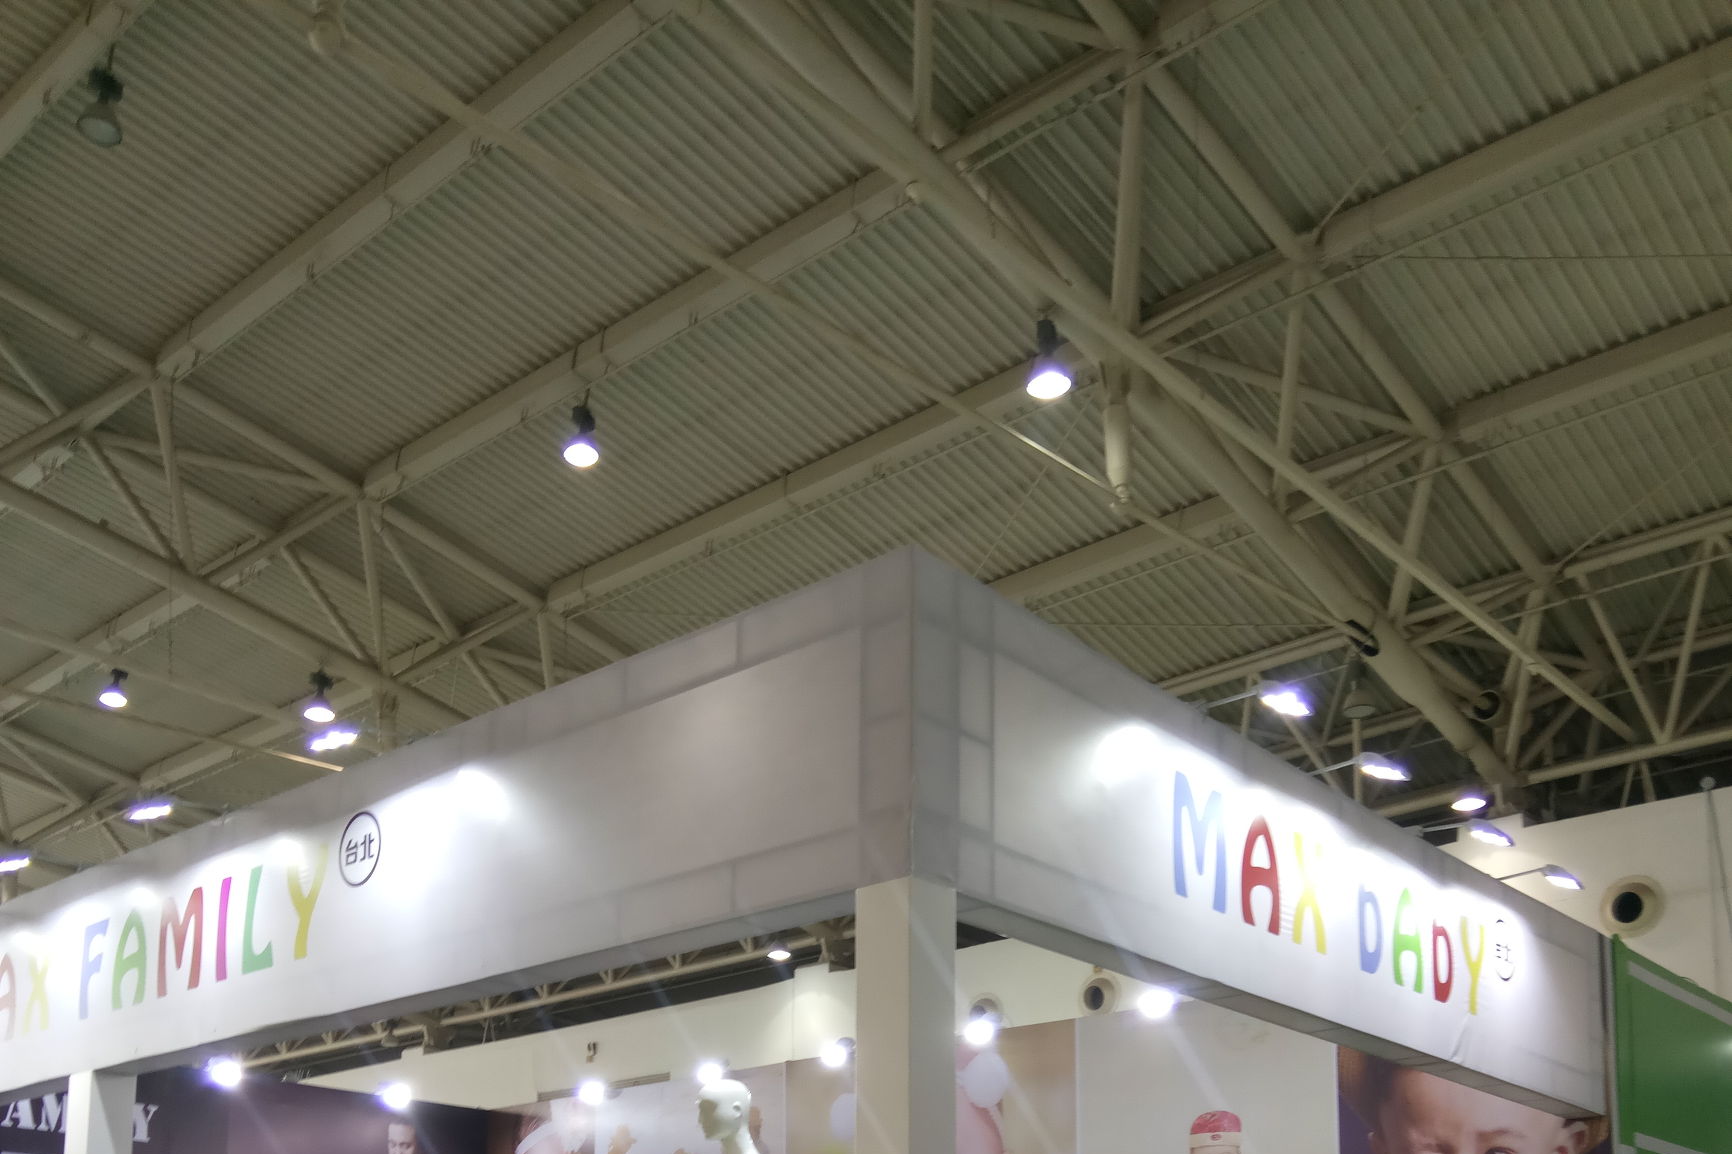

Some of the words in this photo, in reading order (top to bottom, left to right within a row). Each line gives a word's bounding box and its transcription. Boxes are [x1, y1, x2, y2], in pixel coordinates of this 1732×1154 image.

[0, 951, 50, 1041] AX
[78, 842, 330, 1021] FAMILY
[344, 833, 374, 867] 台北
[1173, 770, 1327, 955] MAX
[1358, 882, 1485, 1016] DADY
